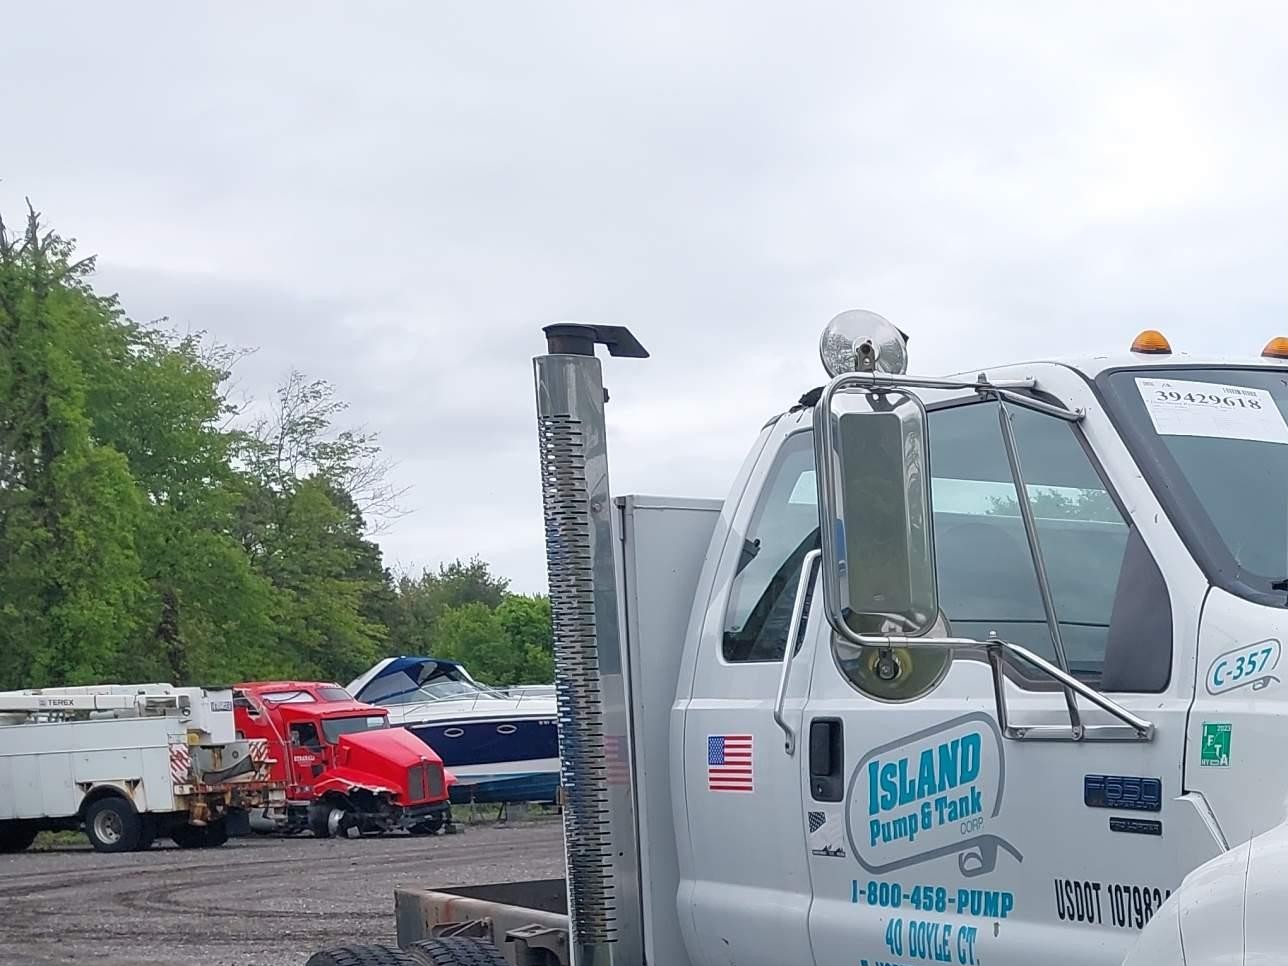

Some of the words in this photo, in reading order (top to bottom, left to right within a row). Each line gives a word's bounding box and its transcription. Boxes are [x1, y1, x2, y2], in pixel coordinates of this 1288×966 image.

[1155, 390, 1262, 410] 39429618
[1213, 648, 1273, 686] C-357
[868, 732, 982, 816] ISLAND
[869, 813, 918, 847] Pump
[921, 802, 932, 830] &
[935, 786, 982, 826] Tank
[852, 879, 1014, 919] 1-800-458-PUMP
[1055, 879, 1101, 925] USDOT
[1107, 884, 1172, 930] 10798
[885, 917, 903, 957] 40
[908, 920, 952, 963] DOYLE
[957, 925, 980, 966] CT.
